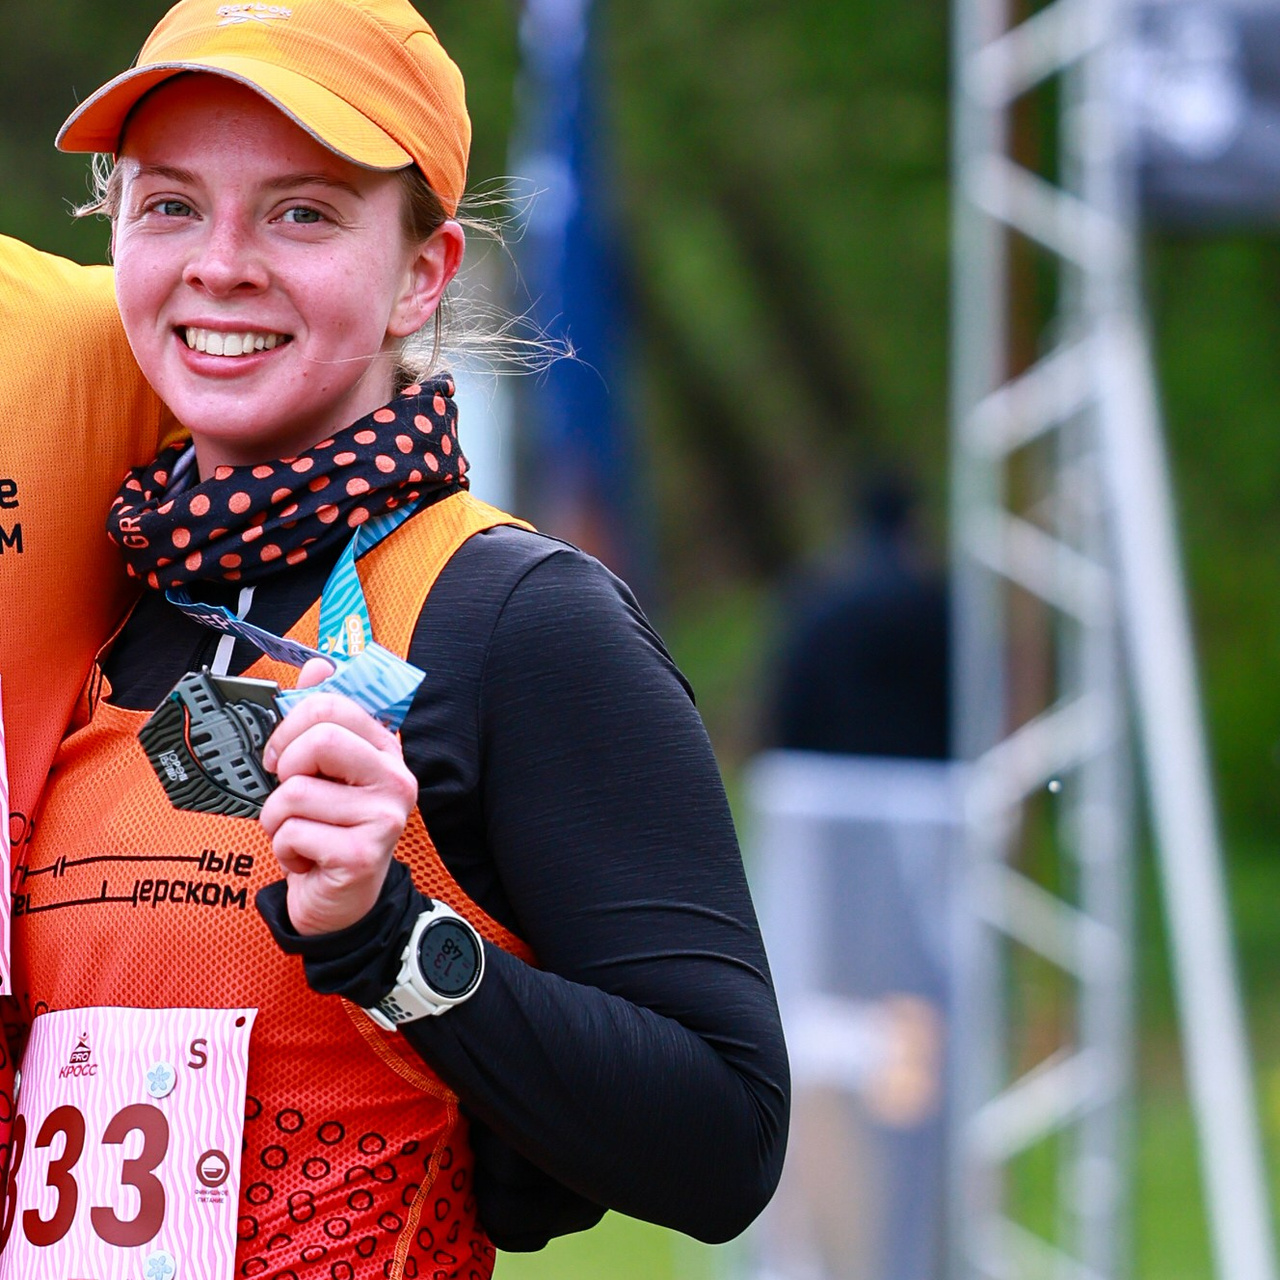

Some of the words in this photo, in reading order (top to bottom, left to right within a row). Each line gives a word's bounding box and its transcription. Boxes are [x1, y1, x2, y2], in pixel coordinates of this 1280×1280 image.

[348, 618, 362, 655] PRO
[70, 1052, 88, 1062] PRO
[187, 1038, 207, 1069] S
[59, 1064, 98, 1079] КРОСС
